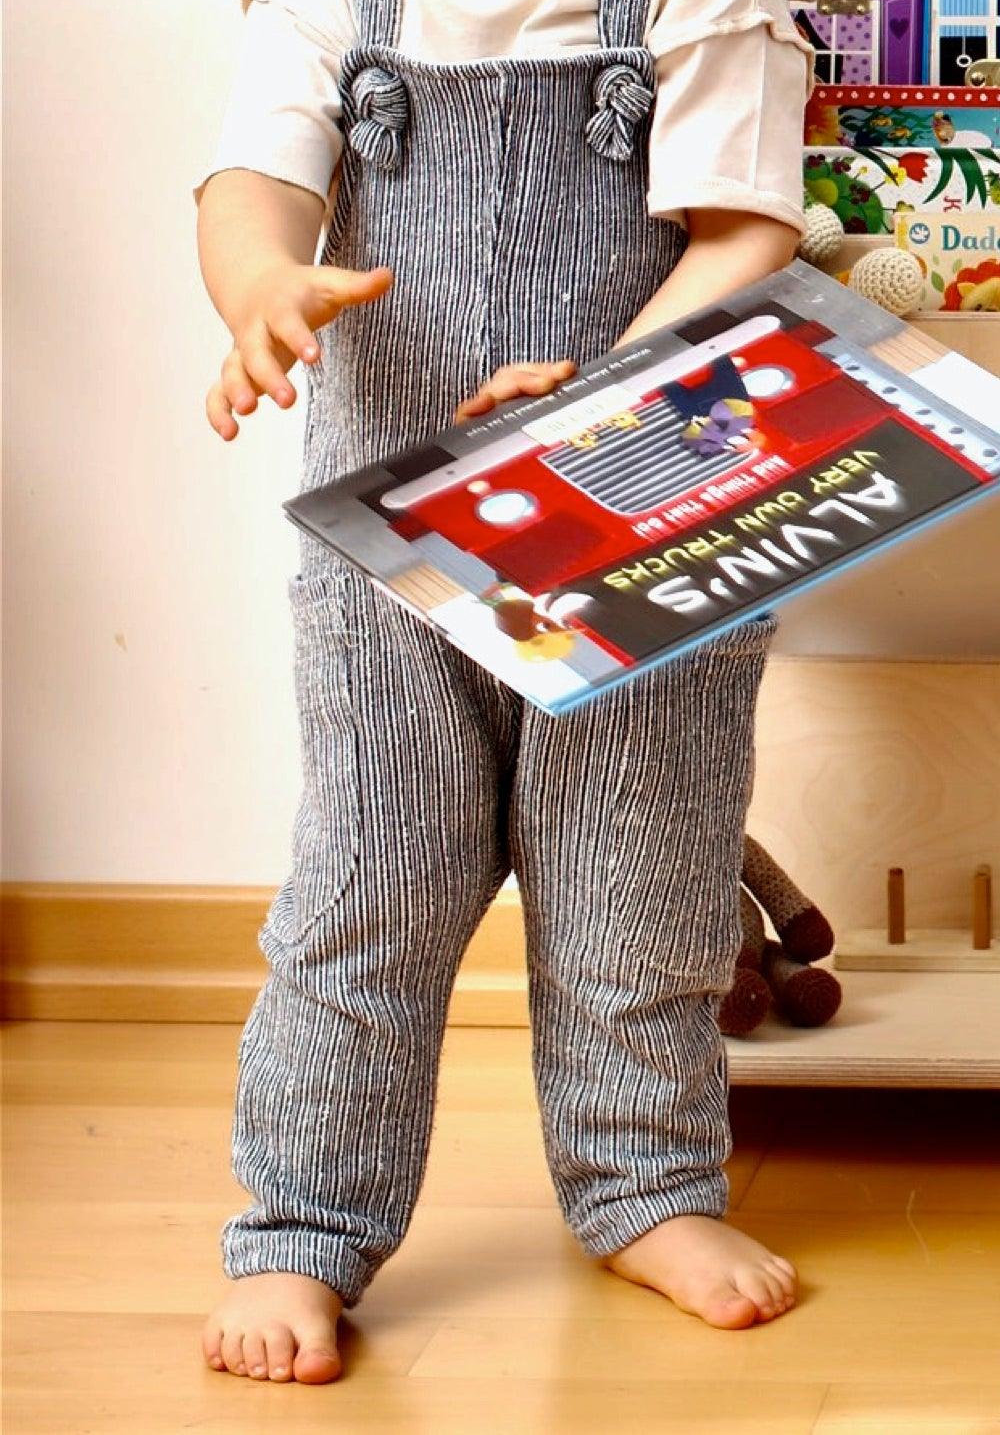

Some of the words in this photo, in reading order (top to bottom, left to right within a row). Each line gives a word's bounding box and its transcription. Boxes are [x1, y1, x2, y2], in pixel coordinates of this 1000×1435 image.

[810, 450, 883, 494] VERY
[735, 491, 805, 533] OWN
[603, 530, 737, 592] TRUCKS
[647, 471, 903, 613] ALVIN'S
